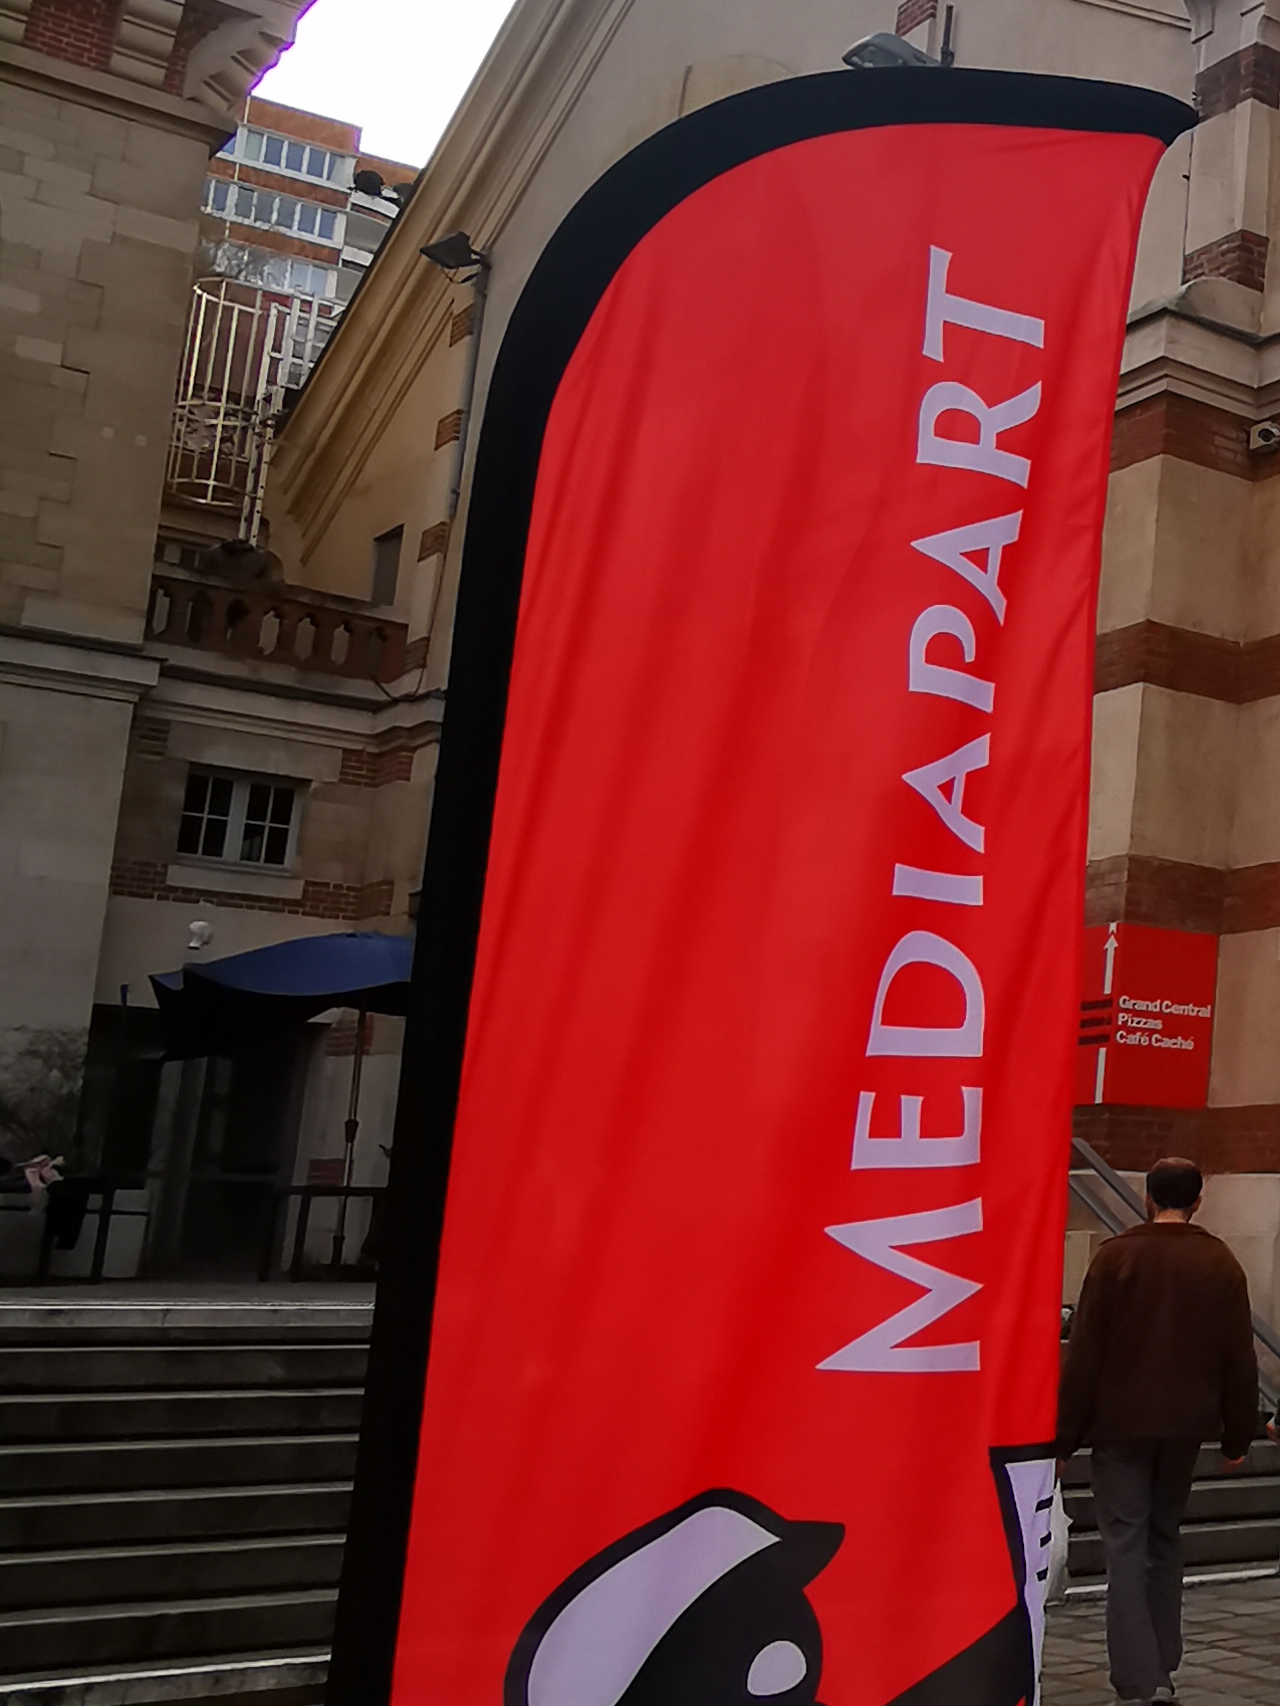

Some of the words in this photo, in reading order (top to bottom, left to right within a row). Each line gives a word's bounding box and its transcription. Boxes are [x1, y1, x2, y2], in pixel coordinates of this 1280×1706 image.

[815, 243, 1047, 1374] MEDIAPART
[1118, 995, 1161, 1013] Grand
[1161, 1000, 1212, 1018] Central
[1117, 1012, 1163, 1030] Pizzas
[1115, 1030, 1150, 1046] Café
